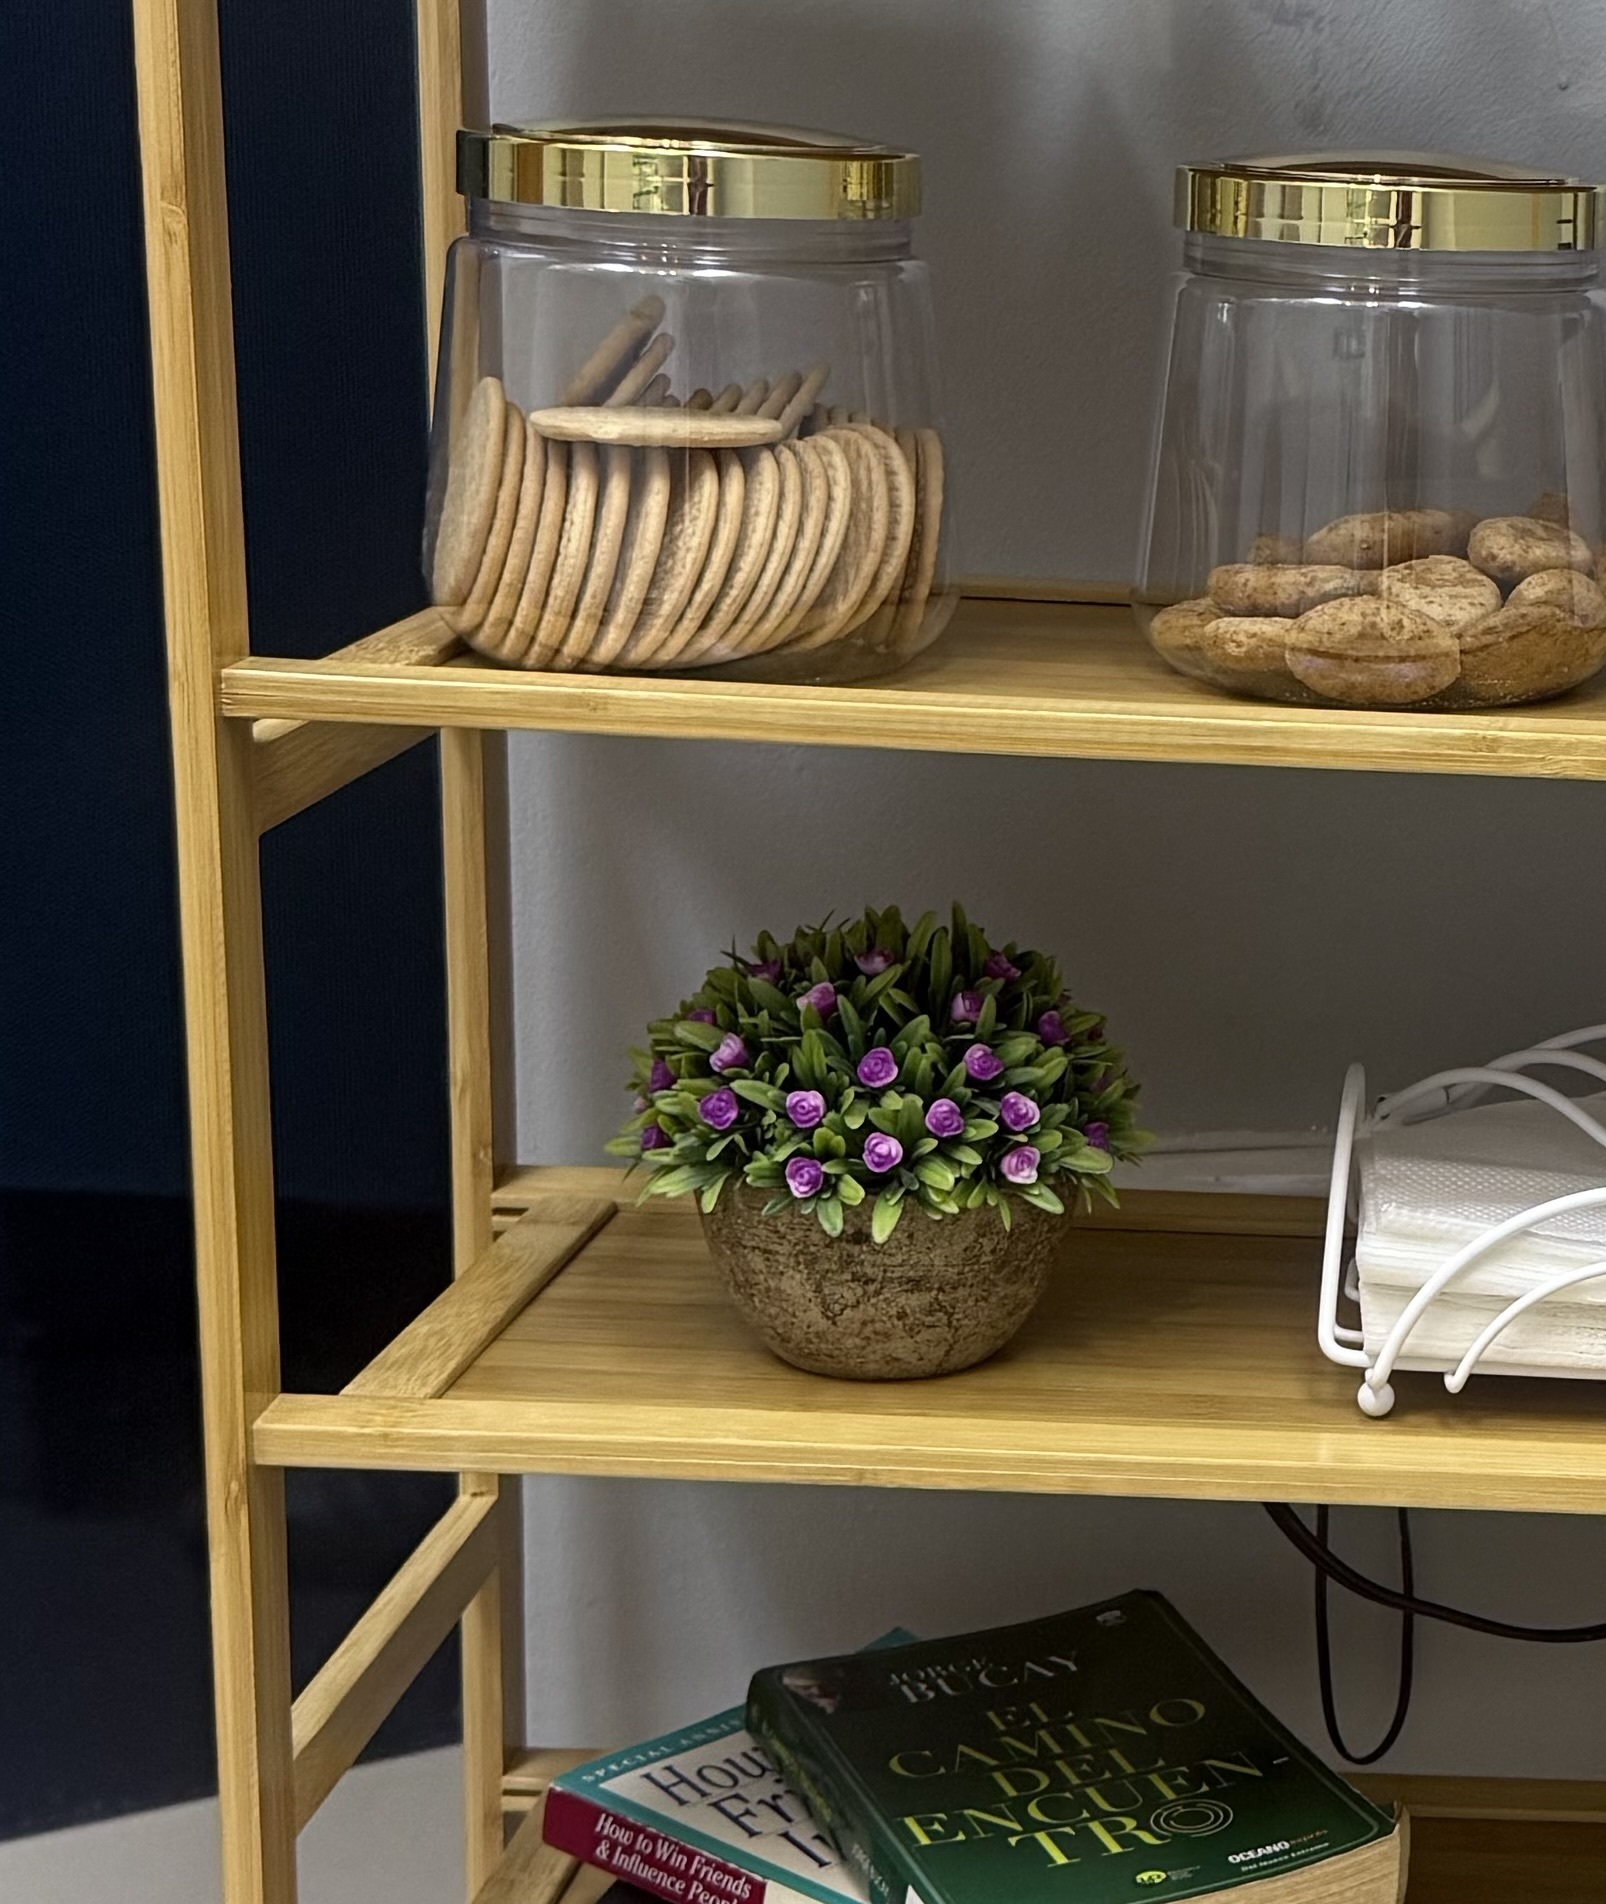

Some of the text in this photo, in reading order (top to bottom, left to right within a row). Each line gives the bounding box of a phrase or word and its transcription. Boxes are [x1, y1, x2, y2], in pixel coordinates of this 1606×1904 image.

[900, 1651, 1078, 1703] BUCAY
[888, 1698, 1206, 1778] CAMINO
[985, 1701, 1074, 1731] EL
[987, 1748, 1166, 1797] DEL
[595, 1812, 752, 1899] How to Win Friends
[596, 1839, 610, 1861] &
[612, 1847, 686, 1895] Influence
[1227, 1840, 1291, 1865] OCEANO
